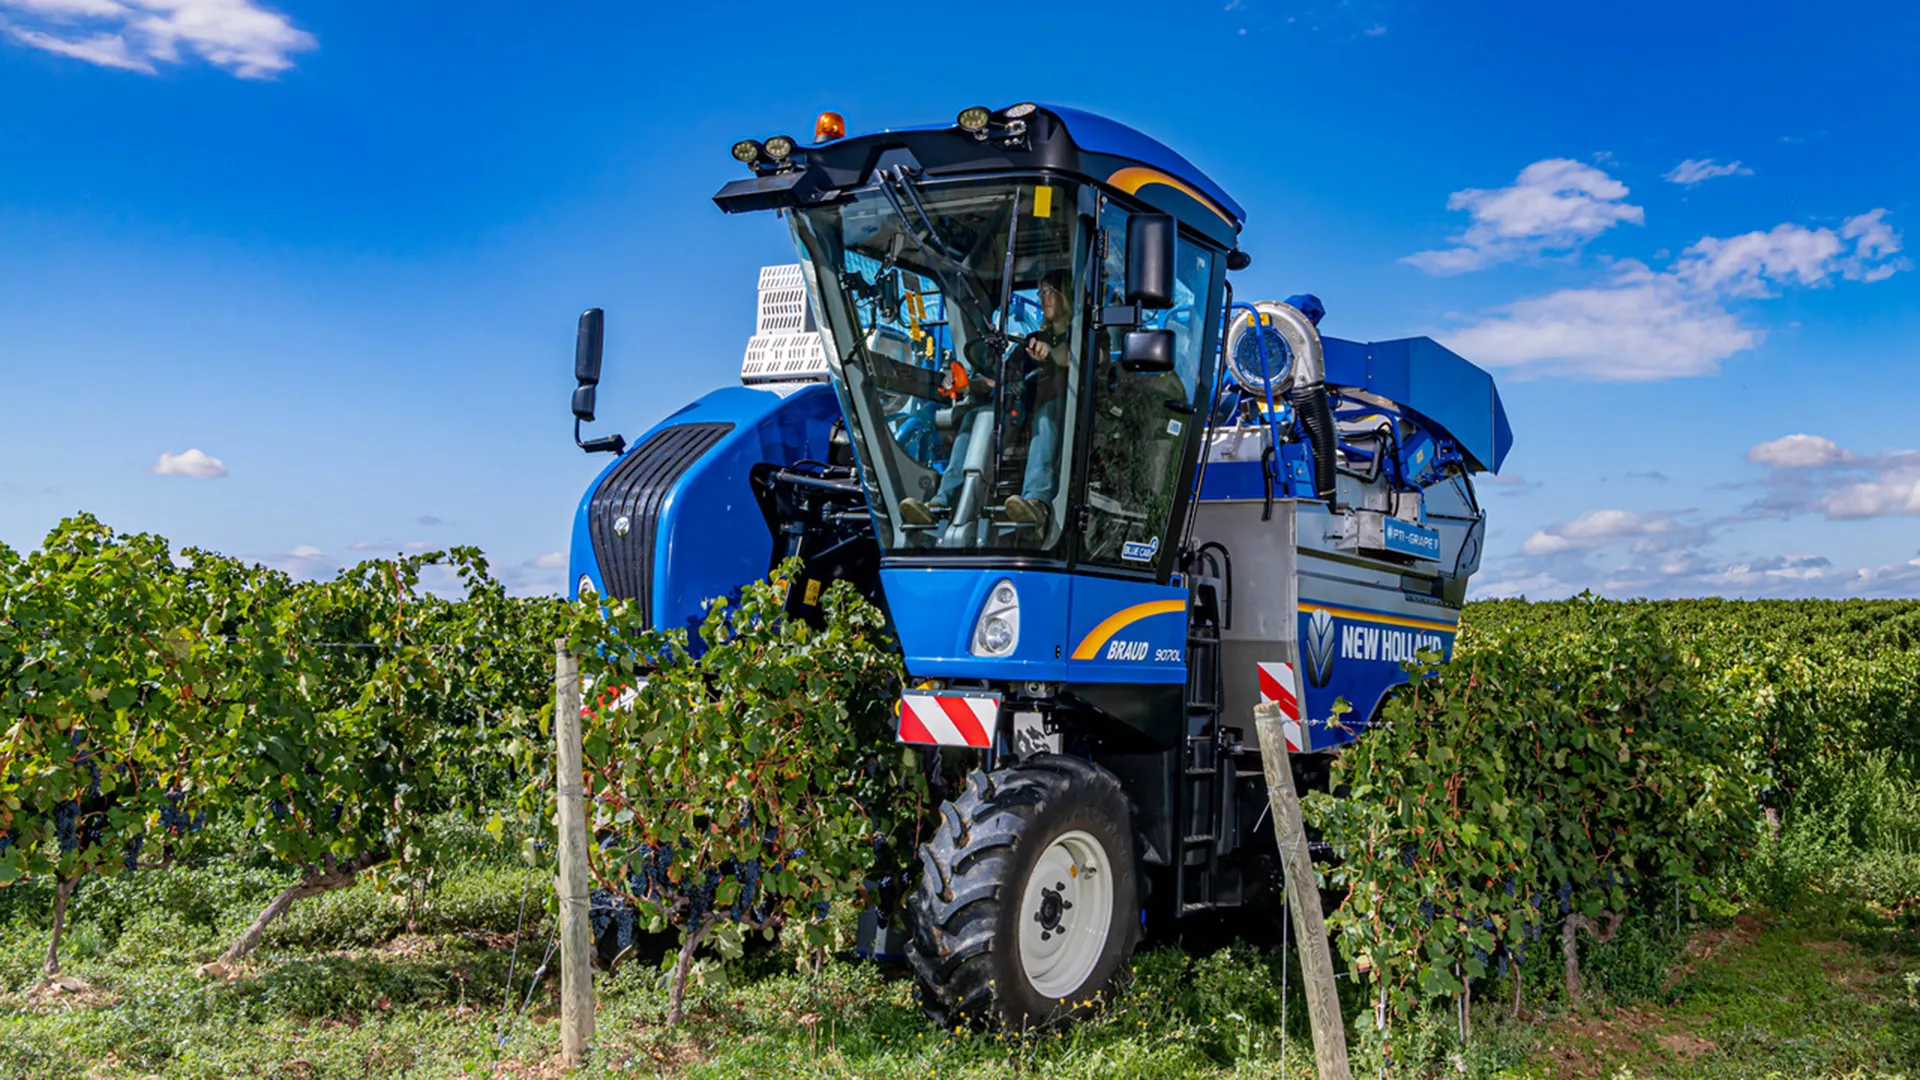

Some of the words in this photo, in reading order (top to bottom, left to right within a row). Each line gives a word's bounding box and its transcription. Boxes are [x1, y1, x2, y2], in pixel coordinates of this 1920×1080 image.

[1106, 640, 1149, 661] BRAUD
[1154, 648, 1181, 662] 9070L
[1341, 624, 1379, 660] NEW
